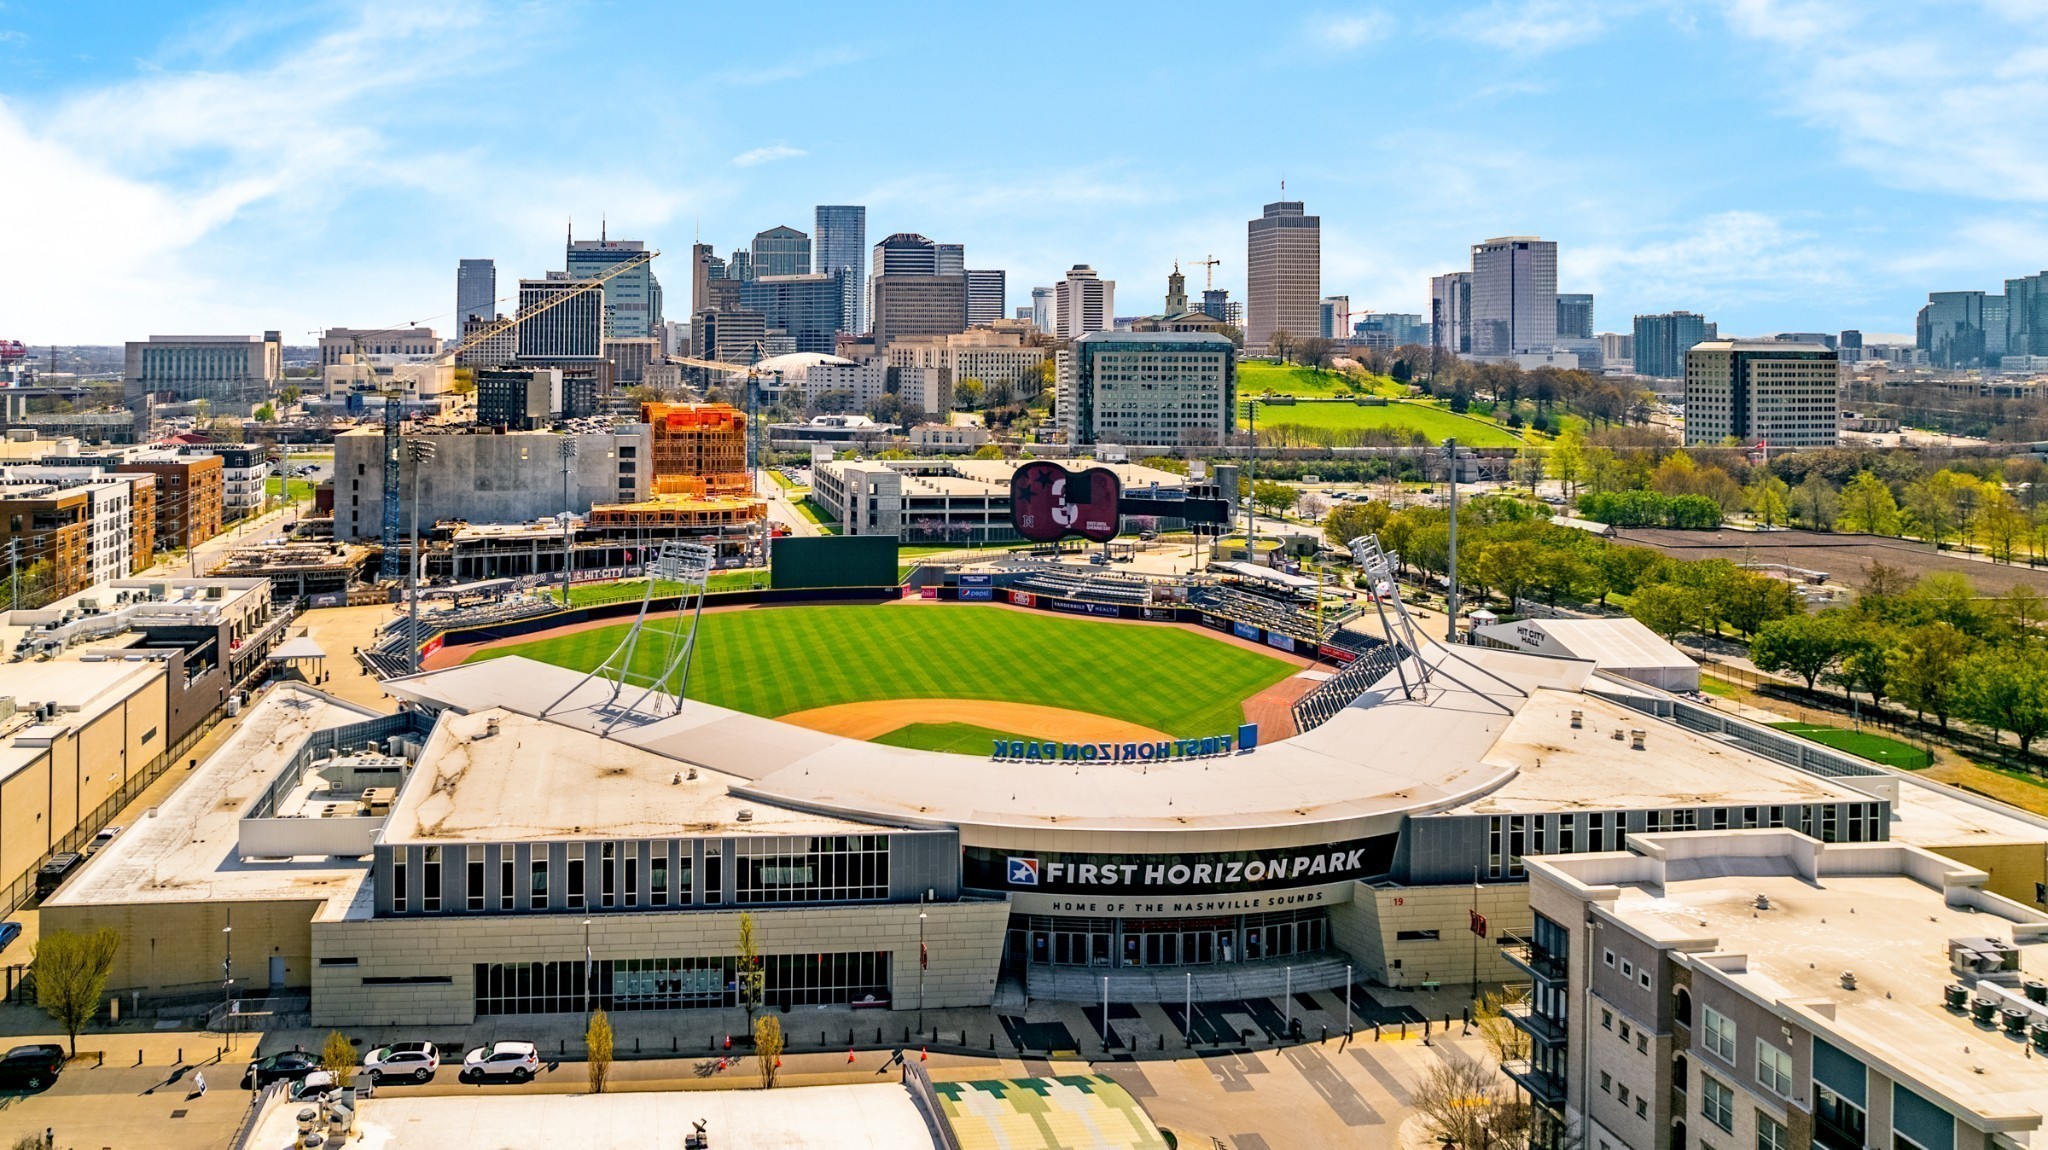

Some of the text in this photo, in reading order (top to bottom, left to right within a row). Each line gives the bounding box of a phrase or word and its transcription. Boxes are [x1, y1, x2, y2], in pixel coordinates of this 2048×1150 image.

[1054, 601, 1085, 610] VANDERBILT
[1517, 626, 1545, 641] HIT CITY
[1521, 636, 1540, 647] HALL
[1047, 848, 1365, 885] FIRST HORIZON PARK
[1053, 892, 1323, 912] HOME OF THE NASHVILLE SOUNDS
[1394, 898, 1404, 906] 19
